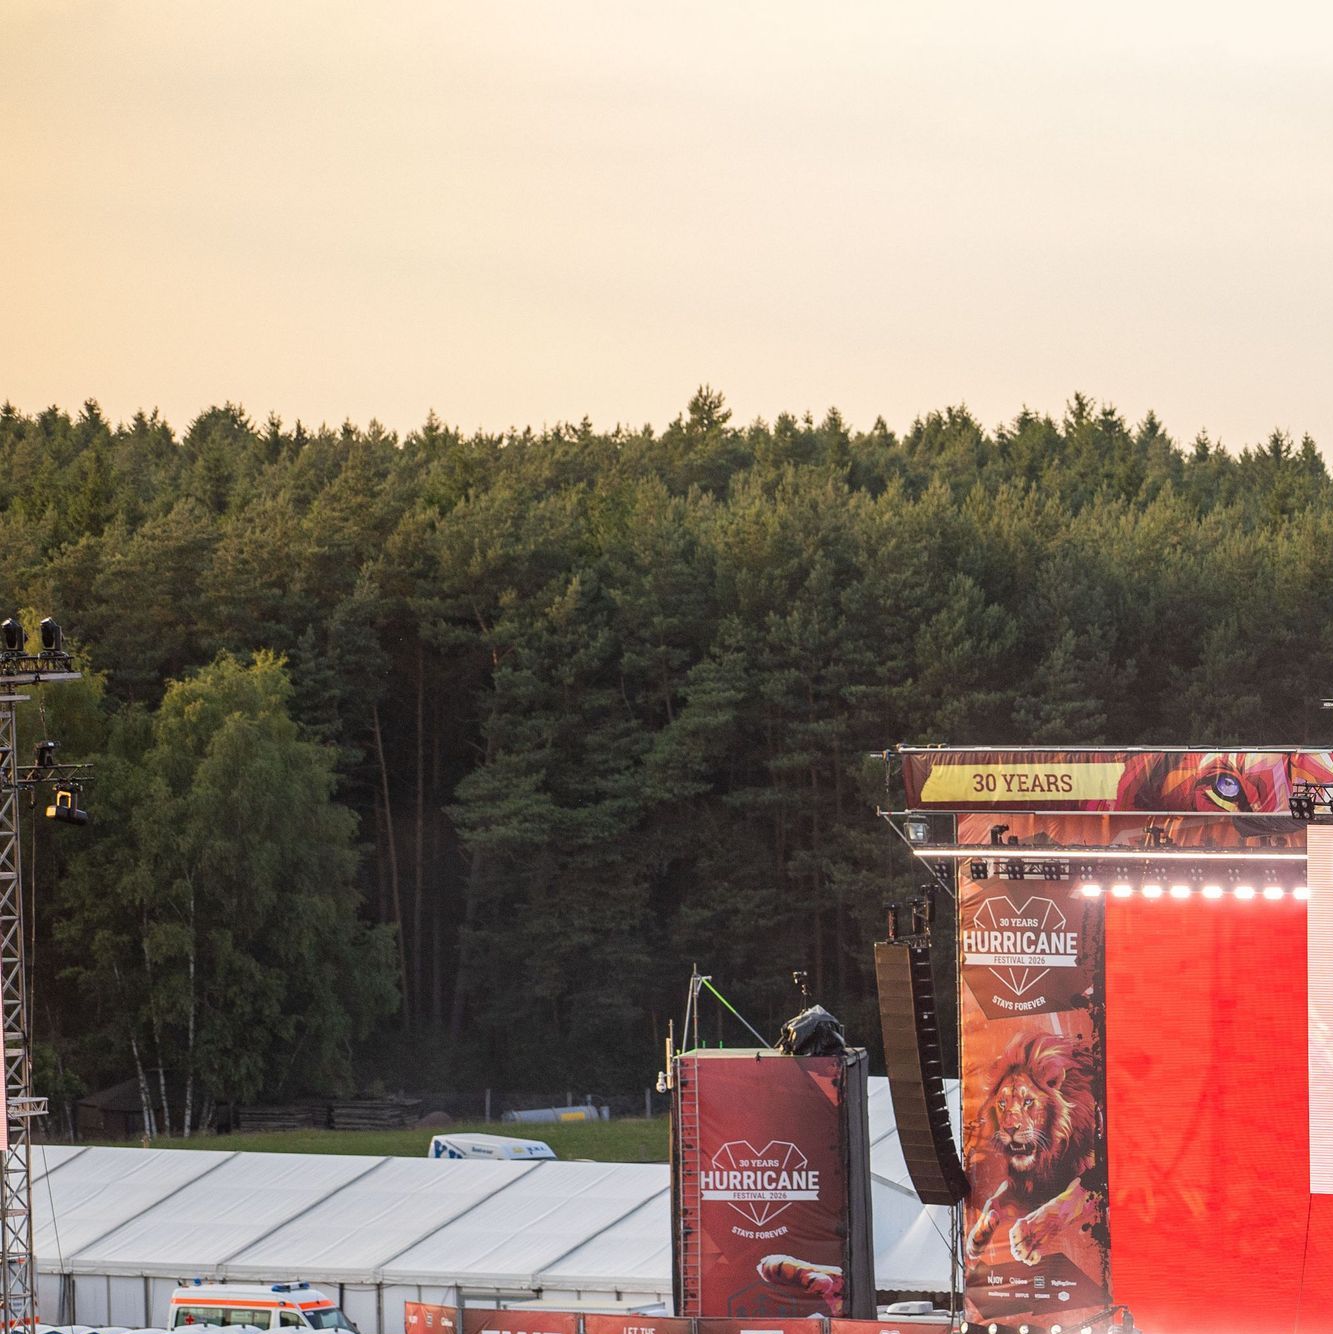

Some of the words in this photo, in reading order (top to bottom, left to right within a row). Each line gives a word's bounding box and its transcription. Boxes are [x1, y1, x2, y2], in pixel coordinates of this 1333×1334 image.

[972, 774, 997, 793] 30
[1003, 774, 1073, 793] YEARS
[999, 918, 1010, 927] 30
[1011, 919, 1039, 927] YEARS
[963, 930, 1078, 954] HURRICANE
[1028, 957, 1046, 965] 2026
[992, 995, 1013, 1010] STAYS
[1014, 996, 1046, 1011] FOREVER
[739, 1159, 749, 1168] 30
[751, 1160, 779, 1168] YEARS
[700, 1171, 820, 1190] HURRICANE
[732, 1226, 754, 1239] STAYS
[756, 1226, 789, 1239] FOREVER
